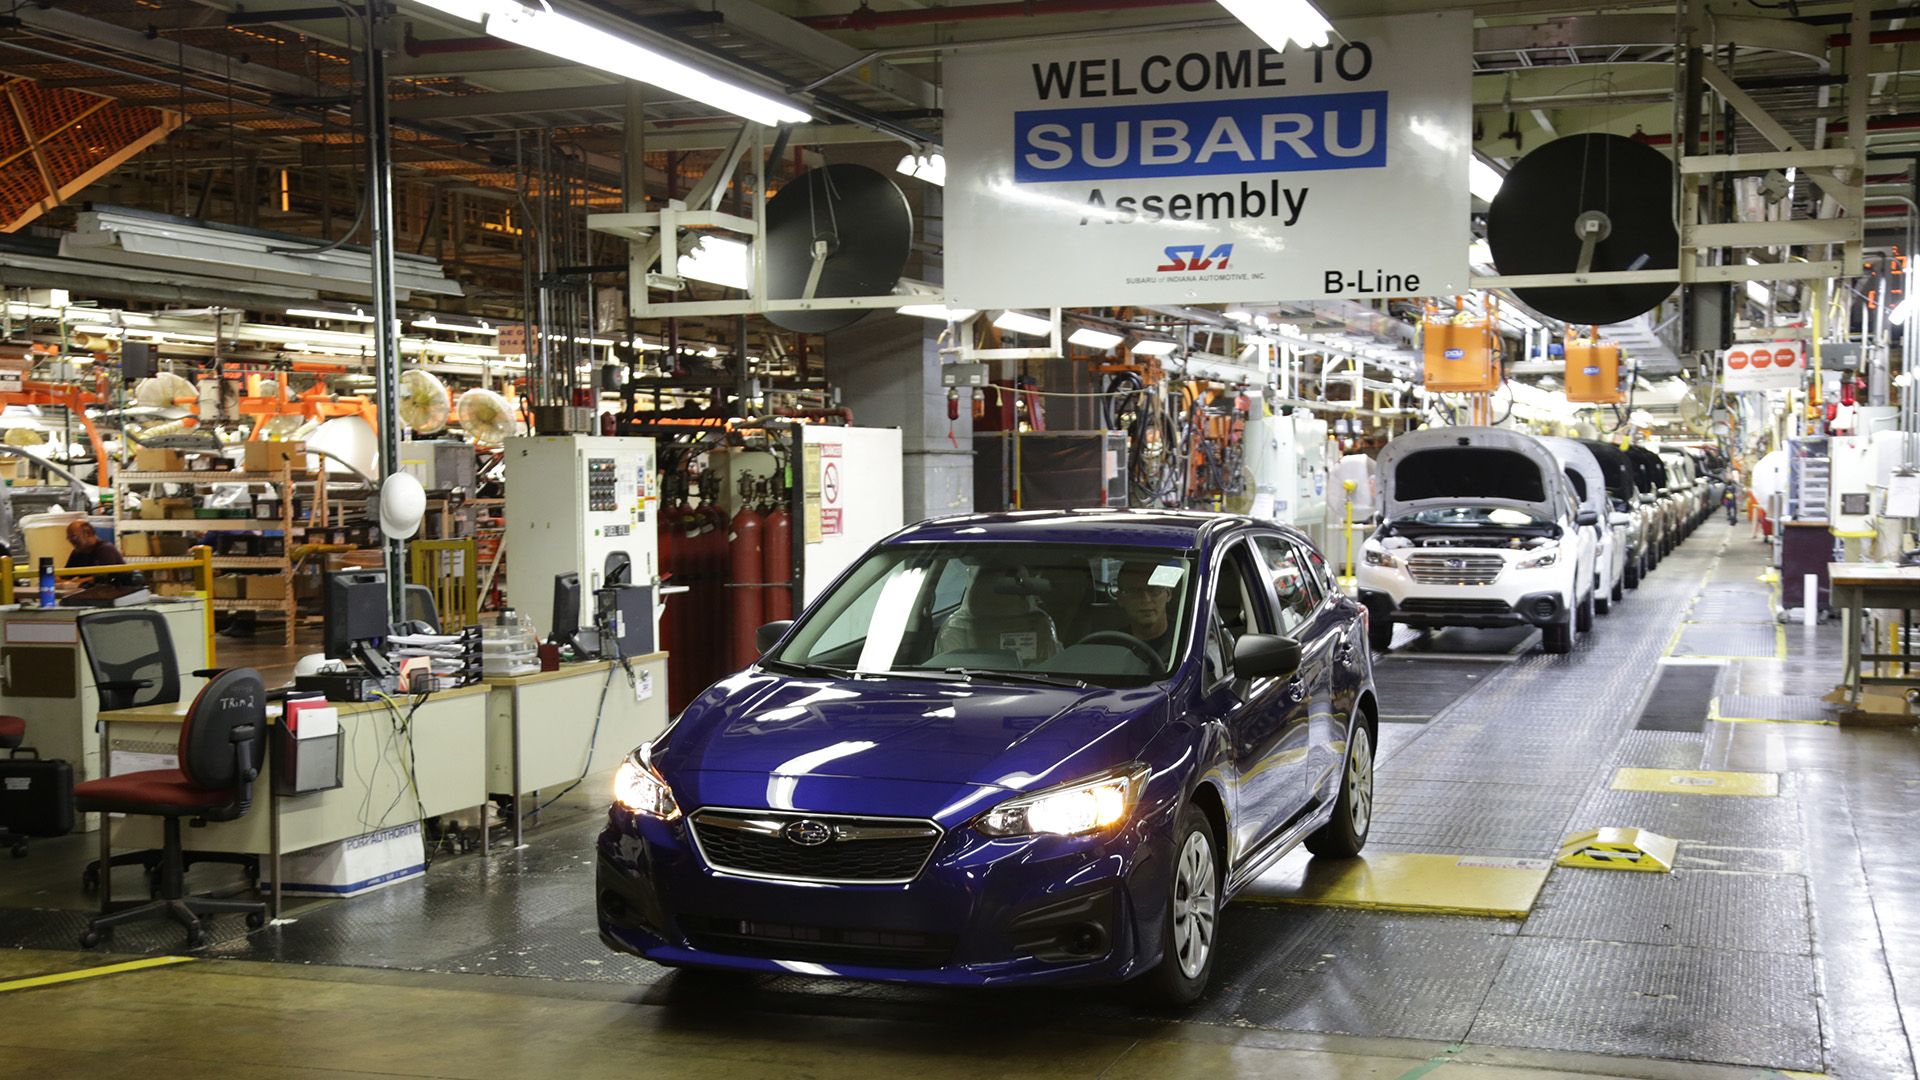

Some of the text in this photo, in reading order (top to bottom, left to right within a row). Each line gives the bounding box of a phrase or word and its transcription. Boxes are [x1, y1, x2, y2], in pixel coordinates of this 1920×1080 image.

[1033, 41, 1372, 100] WELCOME TO
[1024, 109, 1377, 170] SUBARU
[1080, 179, 1309, 226] Assembly
[1125, 277, 1156, 285] SUBARU
[1166, 275, 1197, 283] INDIANA
[1198, 273, 1250, 282] AUTOMOTIVE,
[1251, 272, 1267, 280] INC.
[1324, 269, 1420, 295] B-Line
